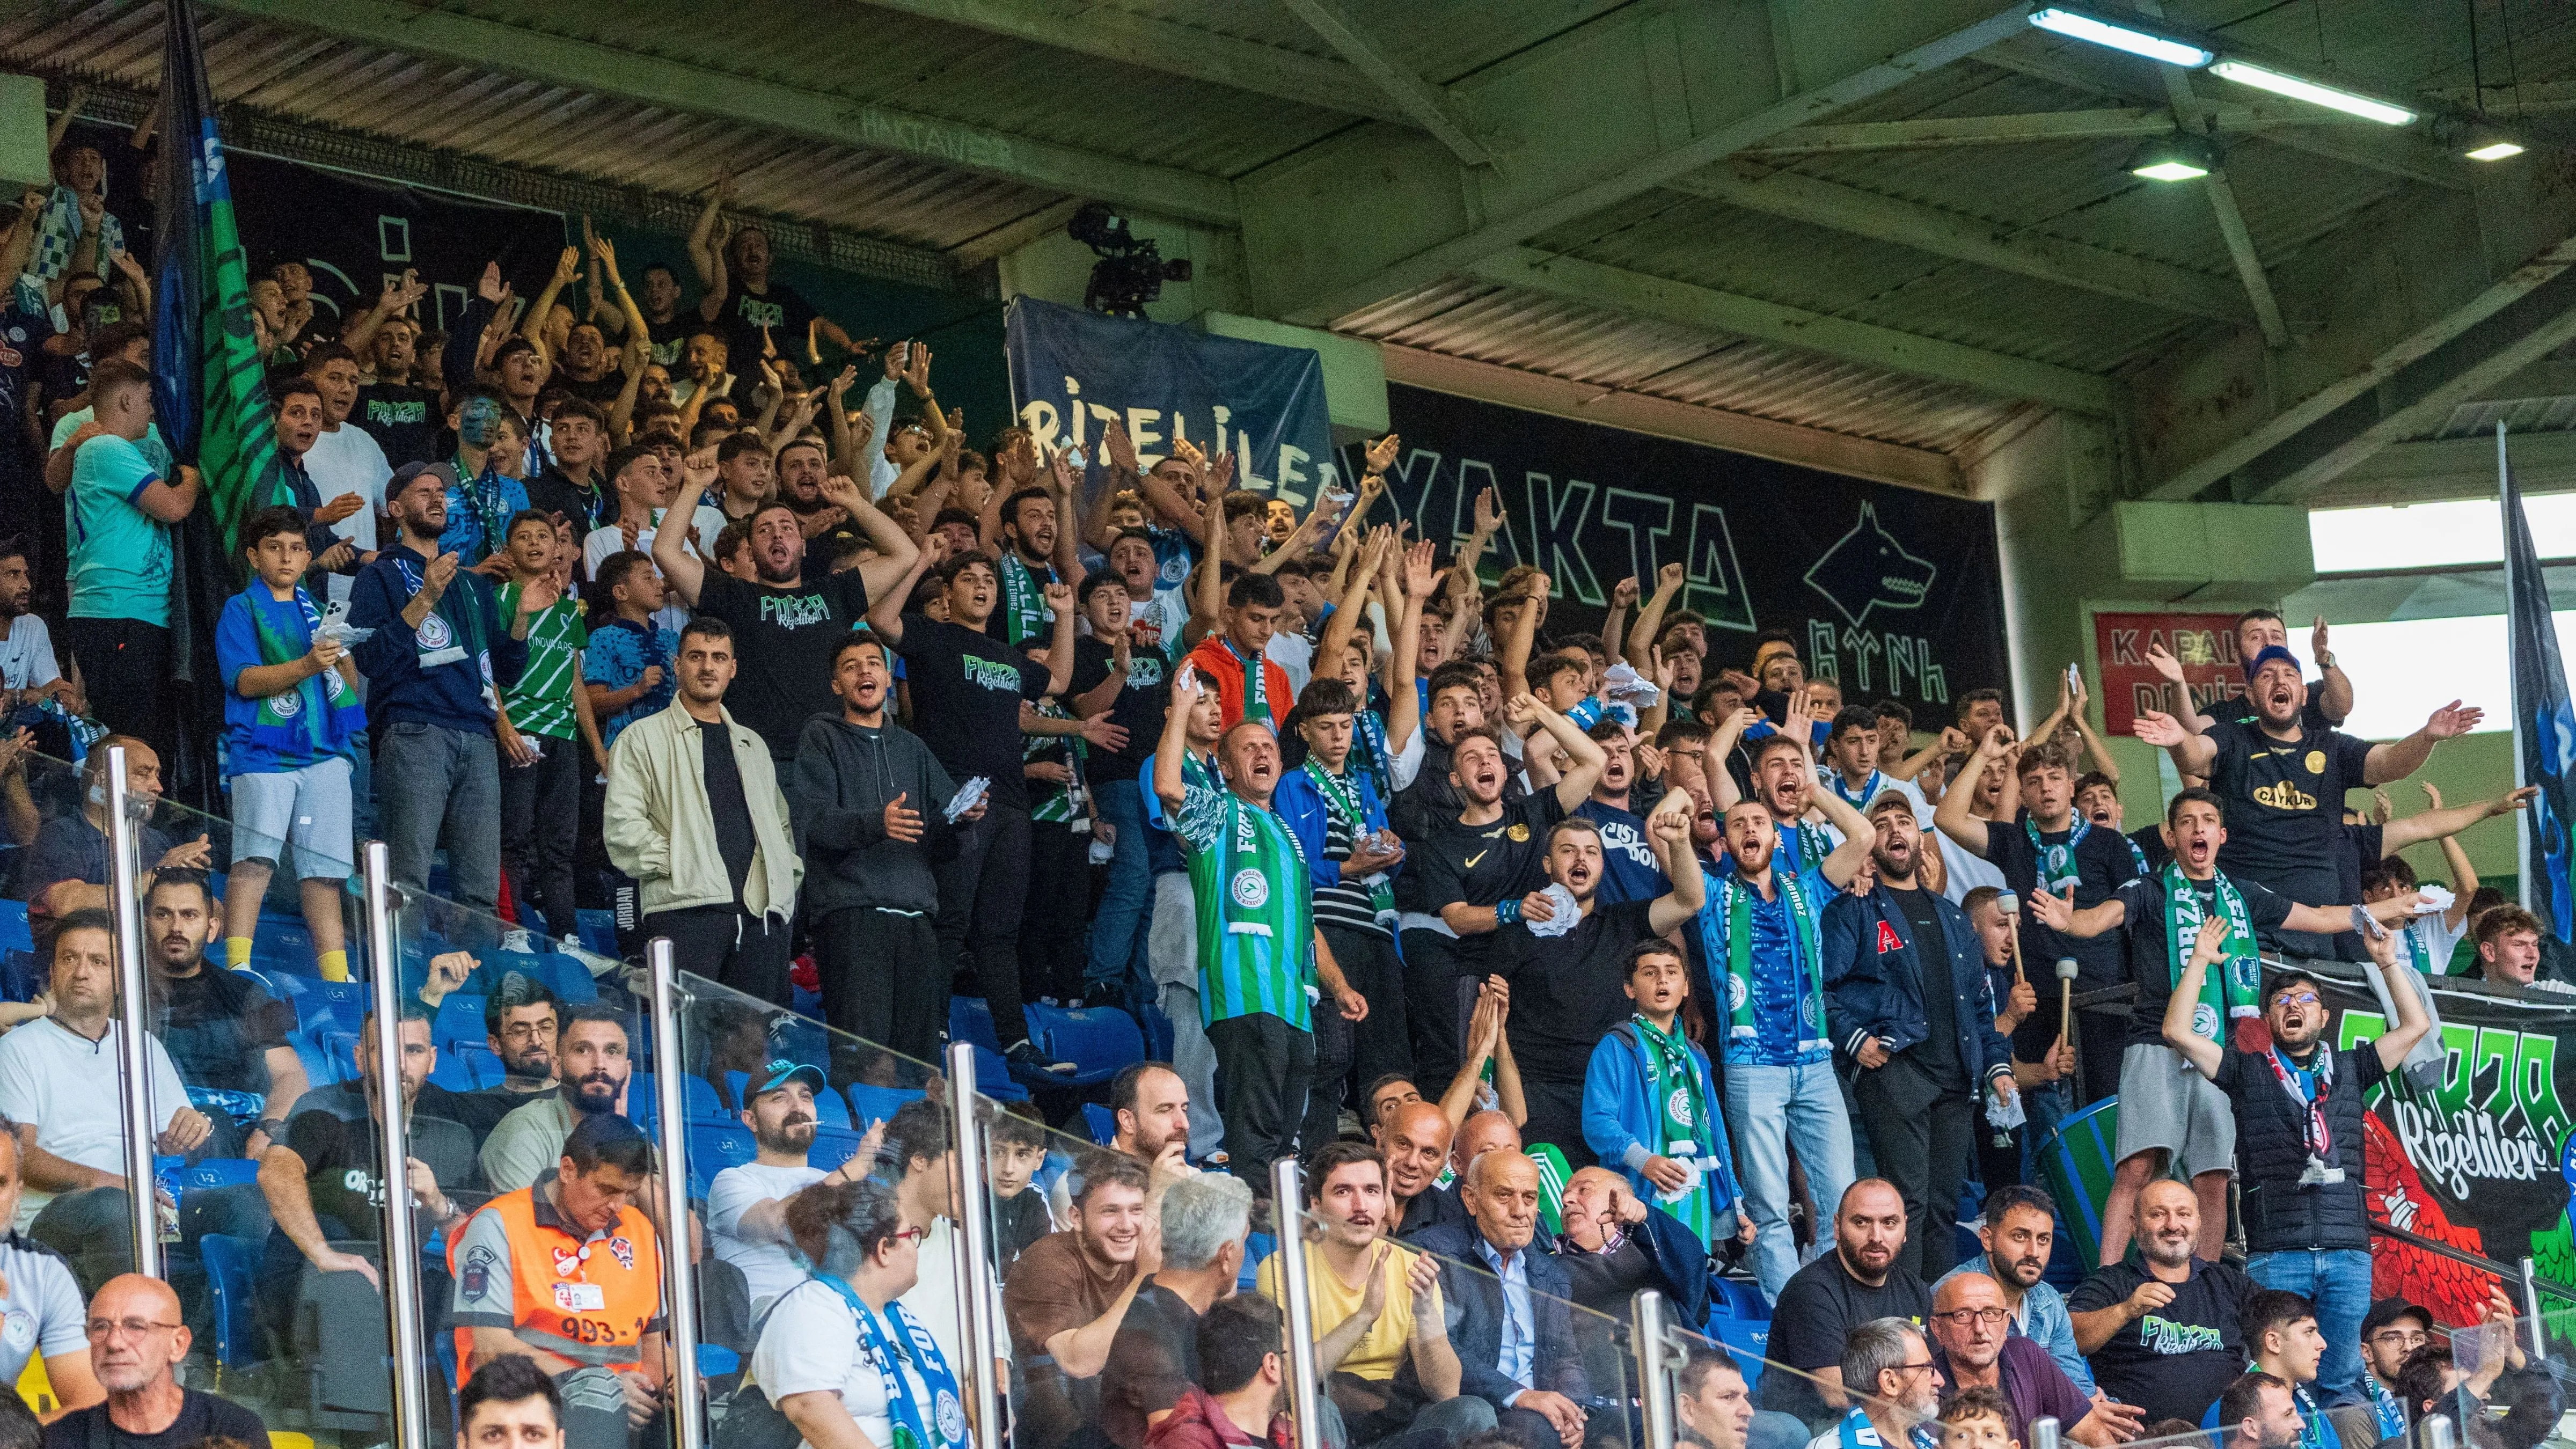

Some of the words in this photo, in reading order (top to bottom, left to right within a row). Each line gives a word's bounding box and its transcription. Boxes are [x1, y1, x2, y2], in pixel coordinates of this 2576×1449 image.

[367, 399, 425, 422] FORZA
[1336, 438, 1758, 633] YAKTA
[760, 594, 830, 621] FORZA
[778, 613, 819, 630] Rizeliler
[2111, 629, 2242, 666] KAPAL
[962, 654, 1020, 693] FORZA
[977, 669, 1016, 690] Rizeliler
[1629, 847, 1651, 866] DO
[1233, 875, 1242, 901] RİZESPOR
[1242, 870, 1262, 880] KULÜBÜ
[617, 886, 634, 931] JORDAN
[1241, 898, 1261, 906] ÇAYKUR
[1877, 920, 1904, 955] A
[2392, 1100, 2547, 1199] Rizeliler
[2140, 1315, 2224, 1351] FORZA
